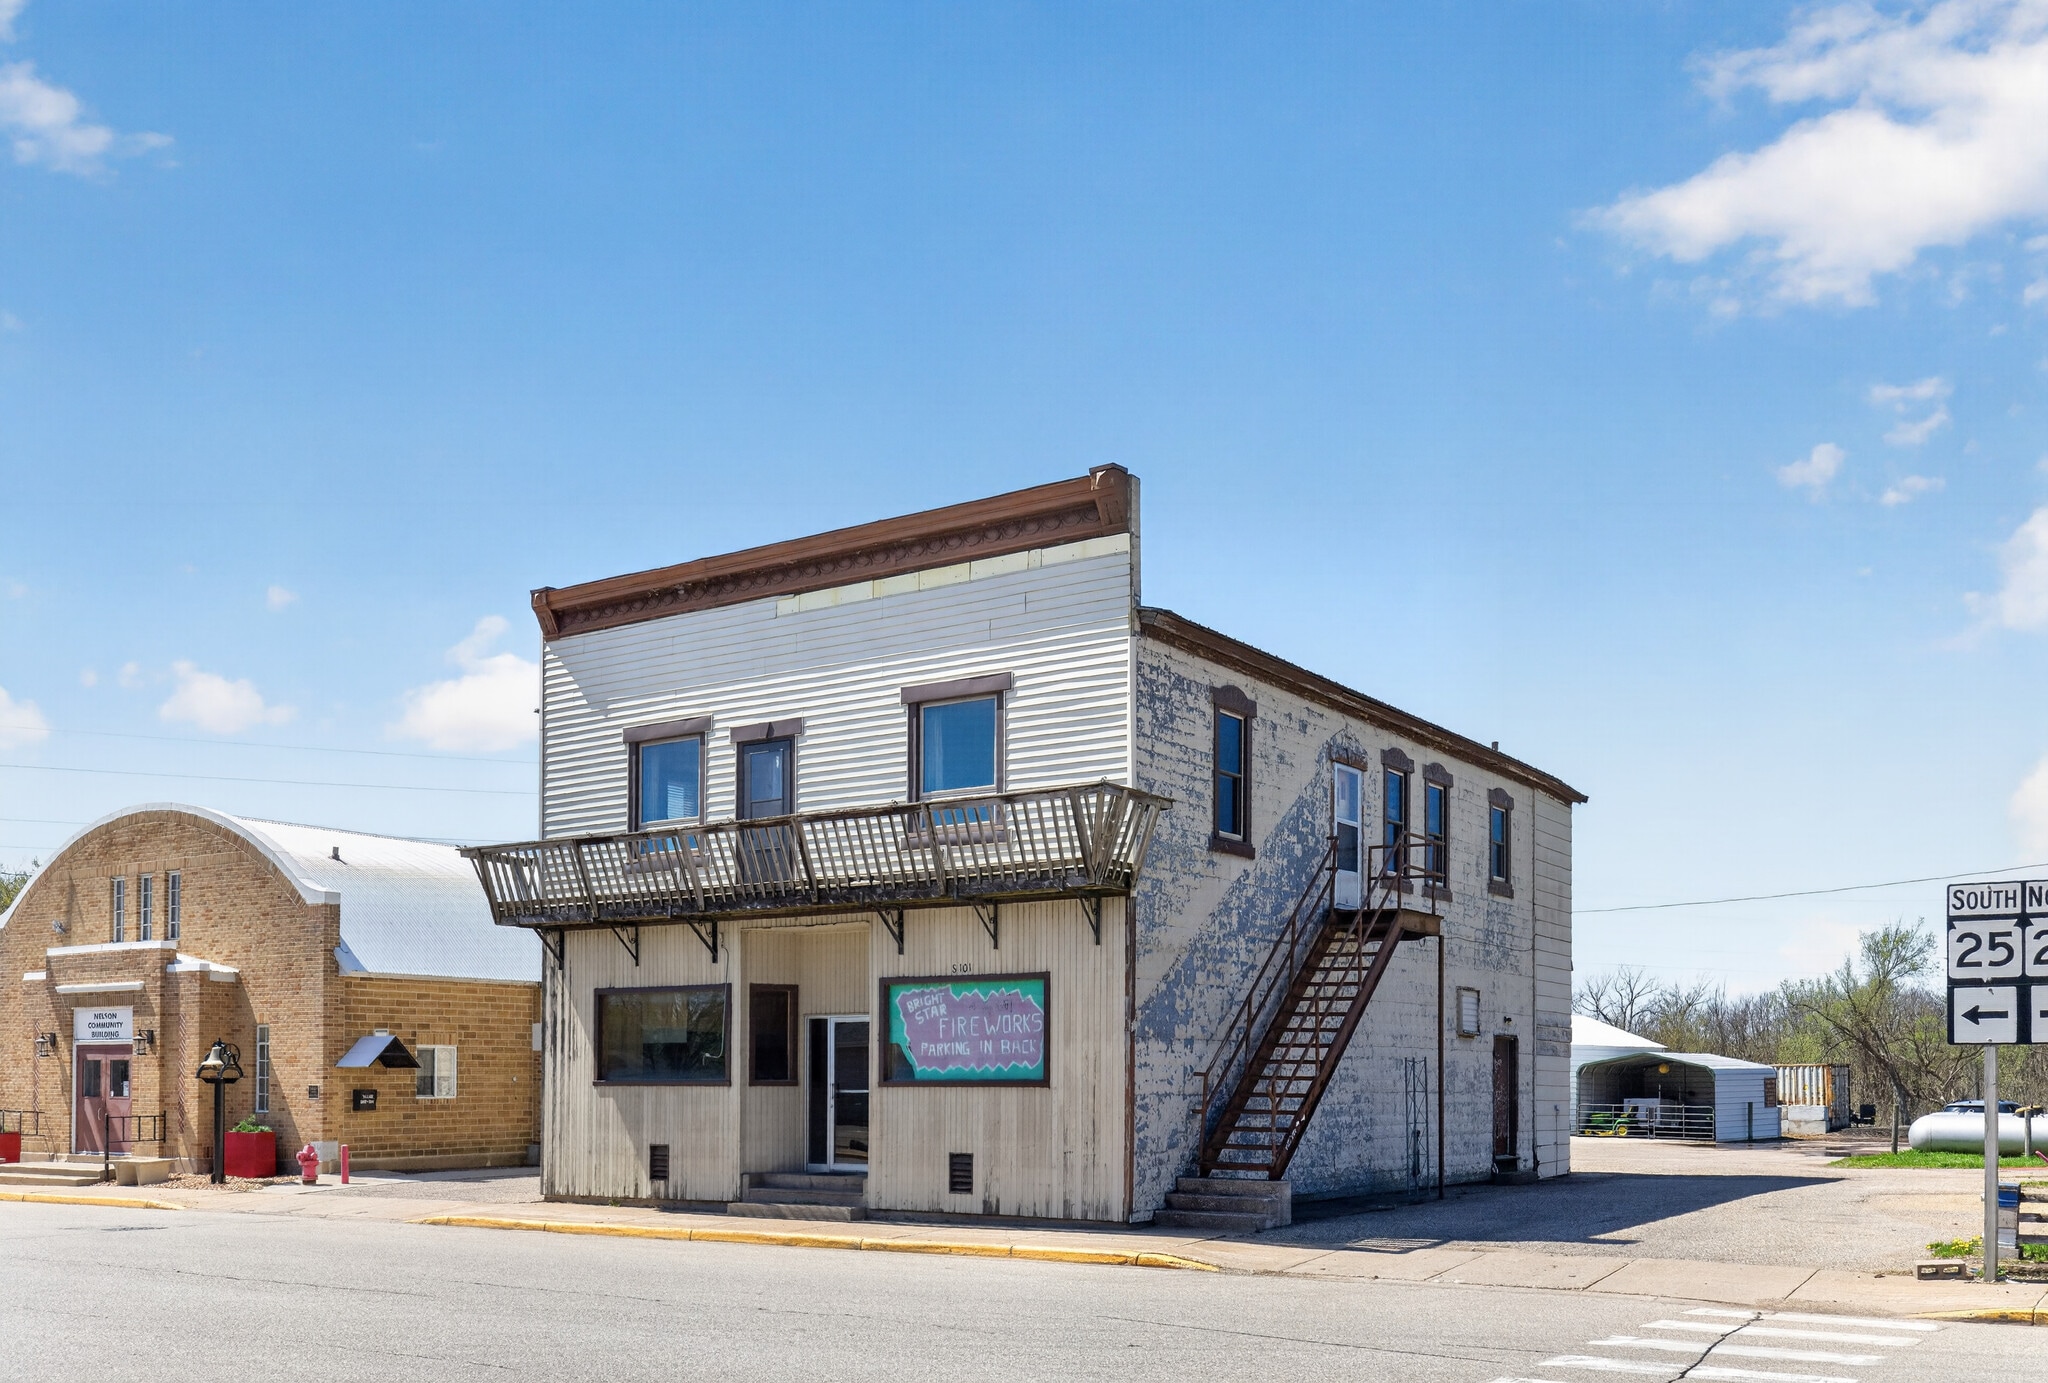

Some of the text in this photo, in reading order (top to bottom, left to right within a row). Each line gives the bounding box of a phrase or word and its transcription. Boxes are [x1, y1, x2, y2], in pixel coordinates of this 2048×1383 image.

[1952, 889, 2017, 910] SOUTH
[2028, 886, 2048, 907] N
[1956, 931, 2015, 967] 25
[906, 994, 944, 1013] BRIGHT
[915, 1004, 947, 1024] STAR
[939, 1012, 1043, 1039] FIREWORKS
[921, 1039, 1037, 1057] PARKING IN BACK
